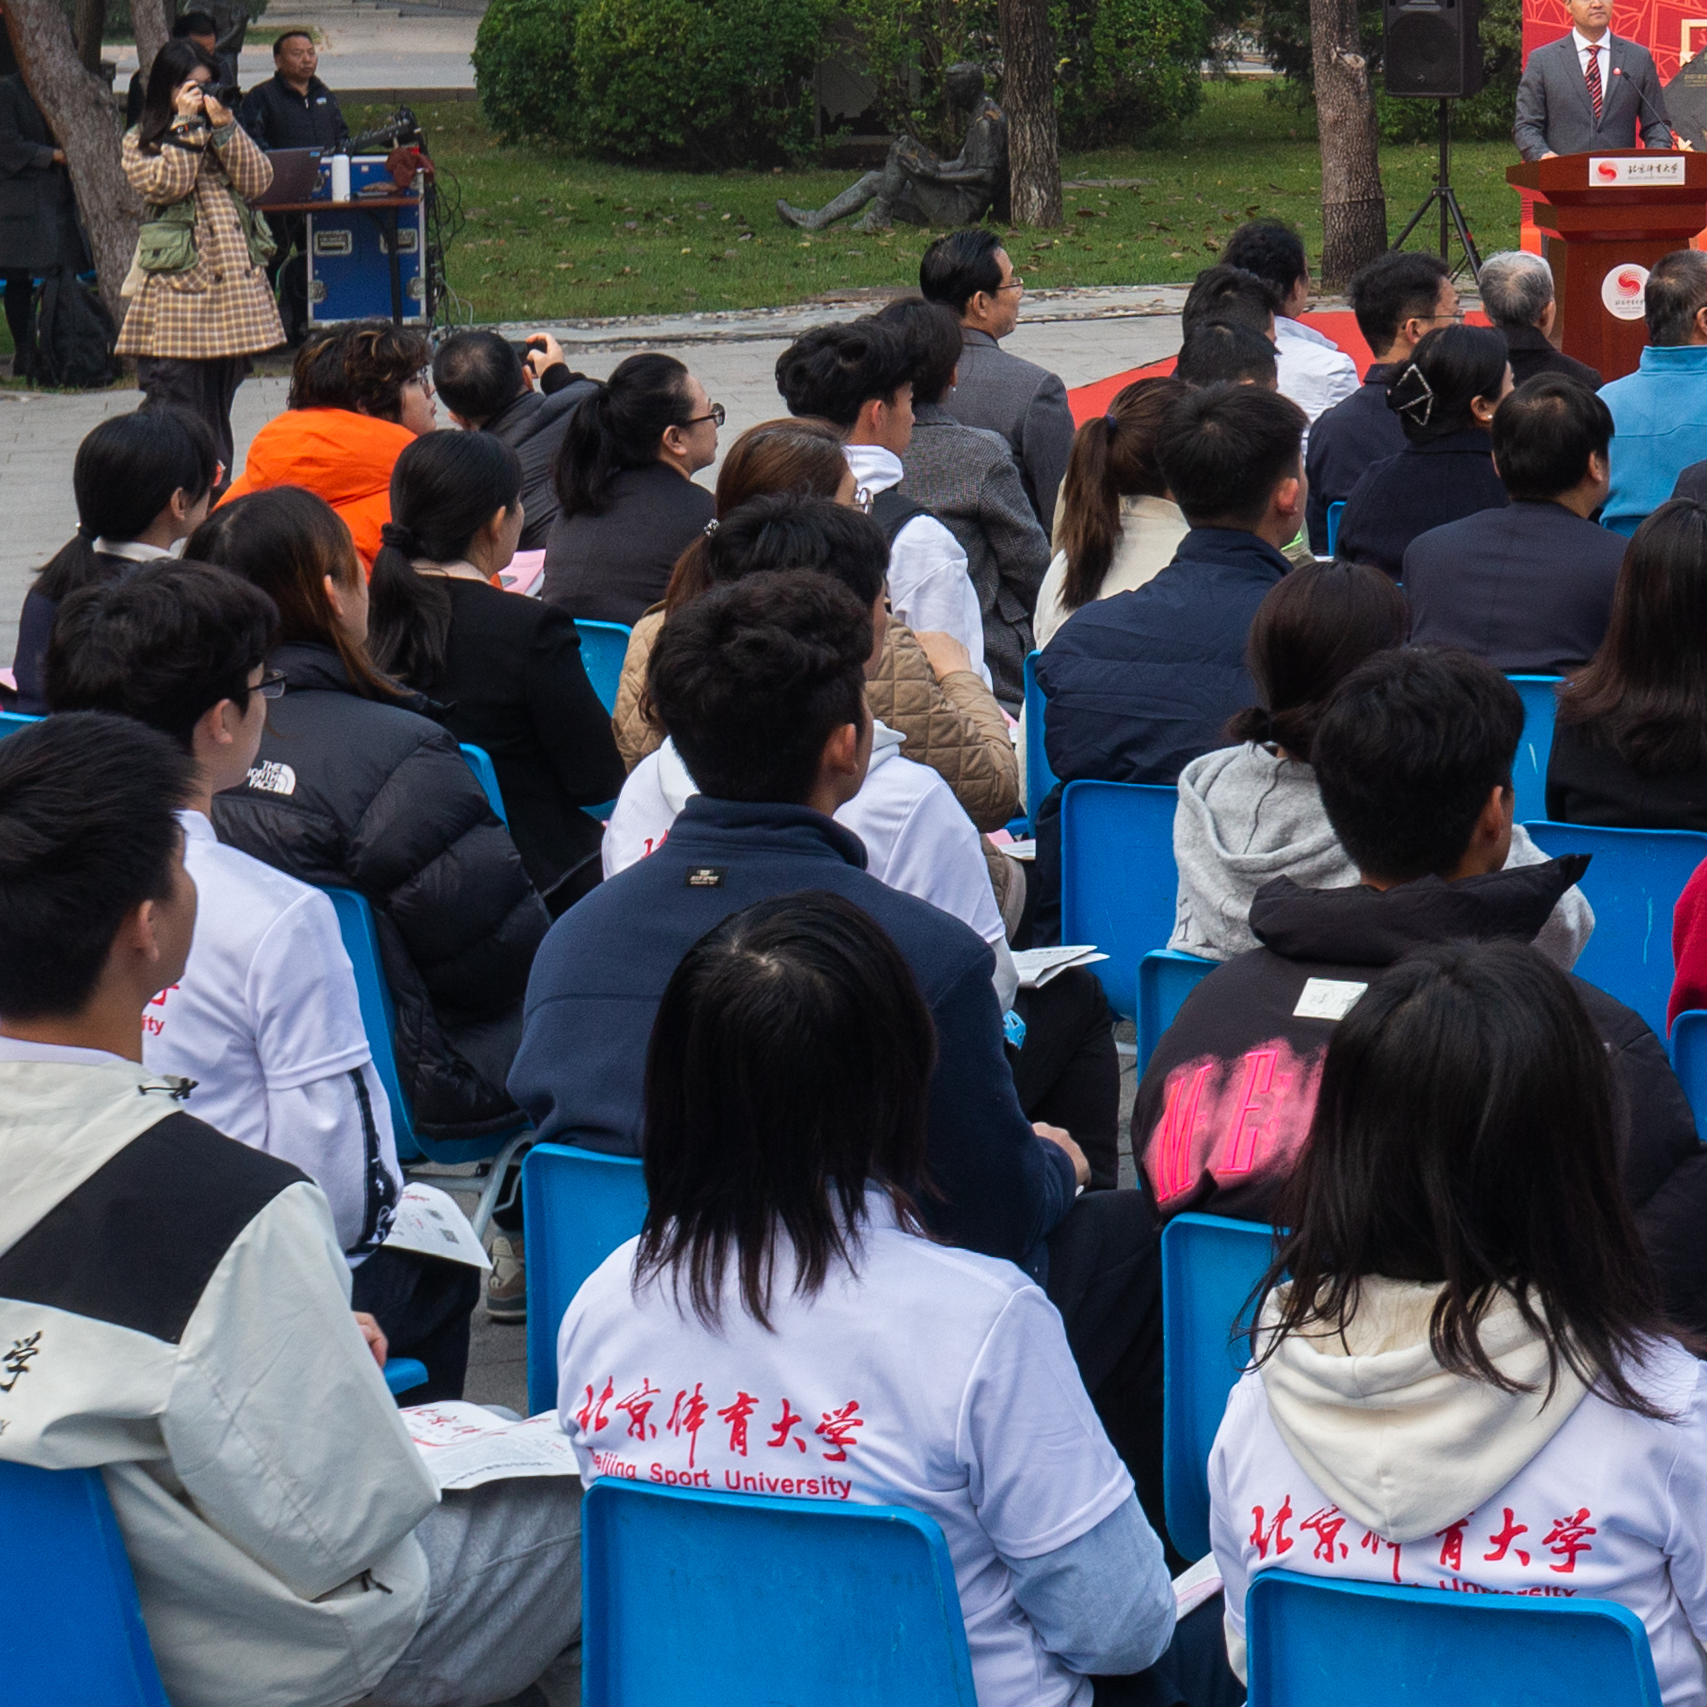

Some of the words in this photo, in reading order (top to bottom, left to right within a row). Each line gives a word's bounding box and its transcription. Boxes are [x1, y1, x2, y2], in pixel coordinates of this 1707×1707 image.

[262, 759, 282, 771] THE
[248, 776, 275, 792] FACE
[575, 1375, 864, 1469] 北京体育大学
[649, 1462, 712, 1489] Sport
[724, 1469, 853, 1500] University
